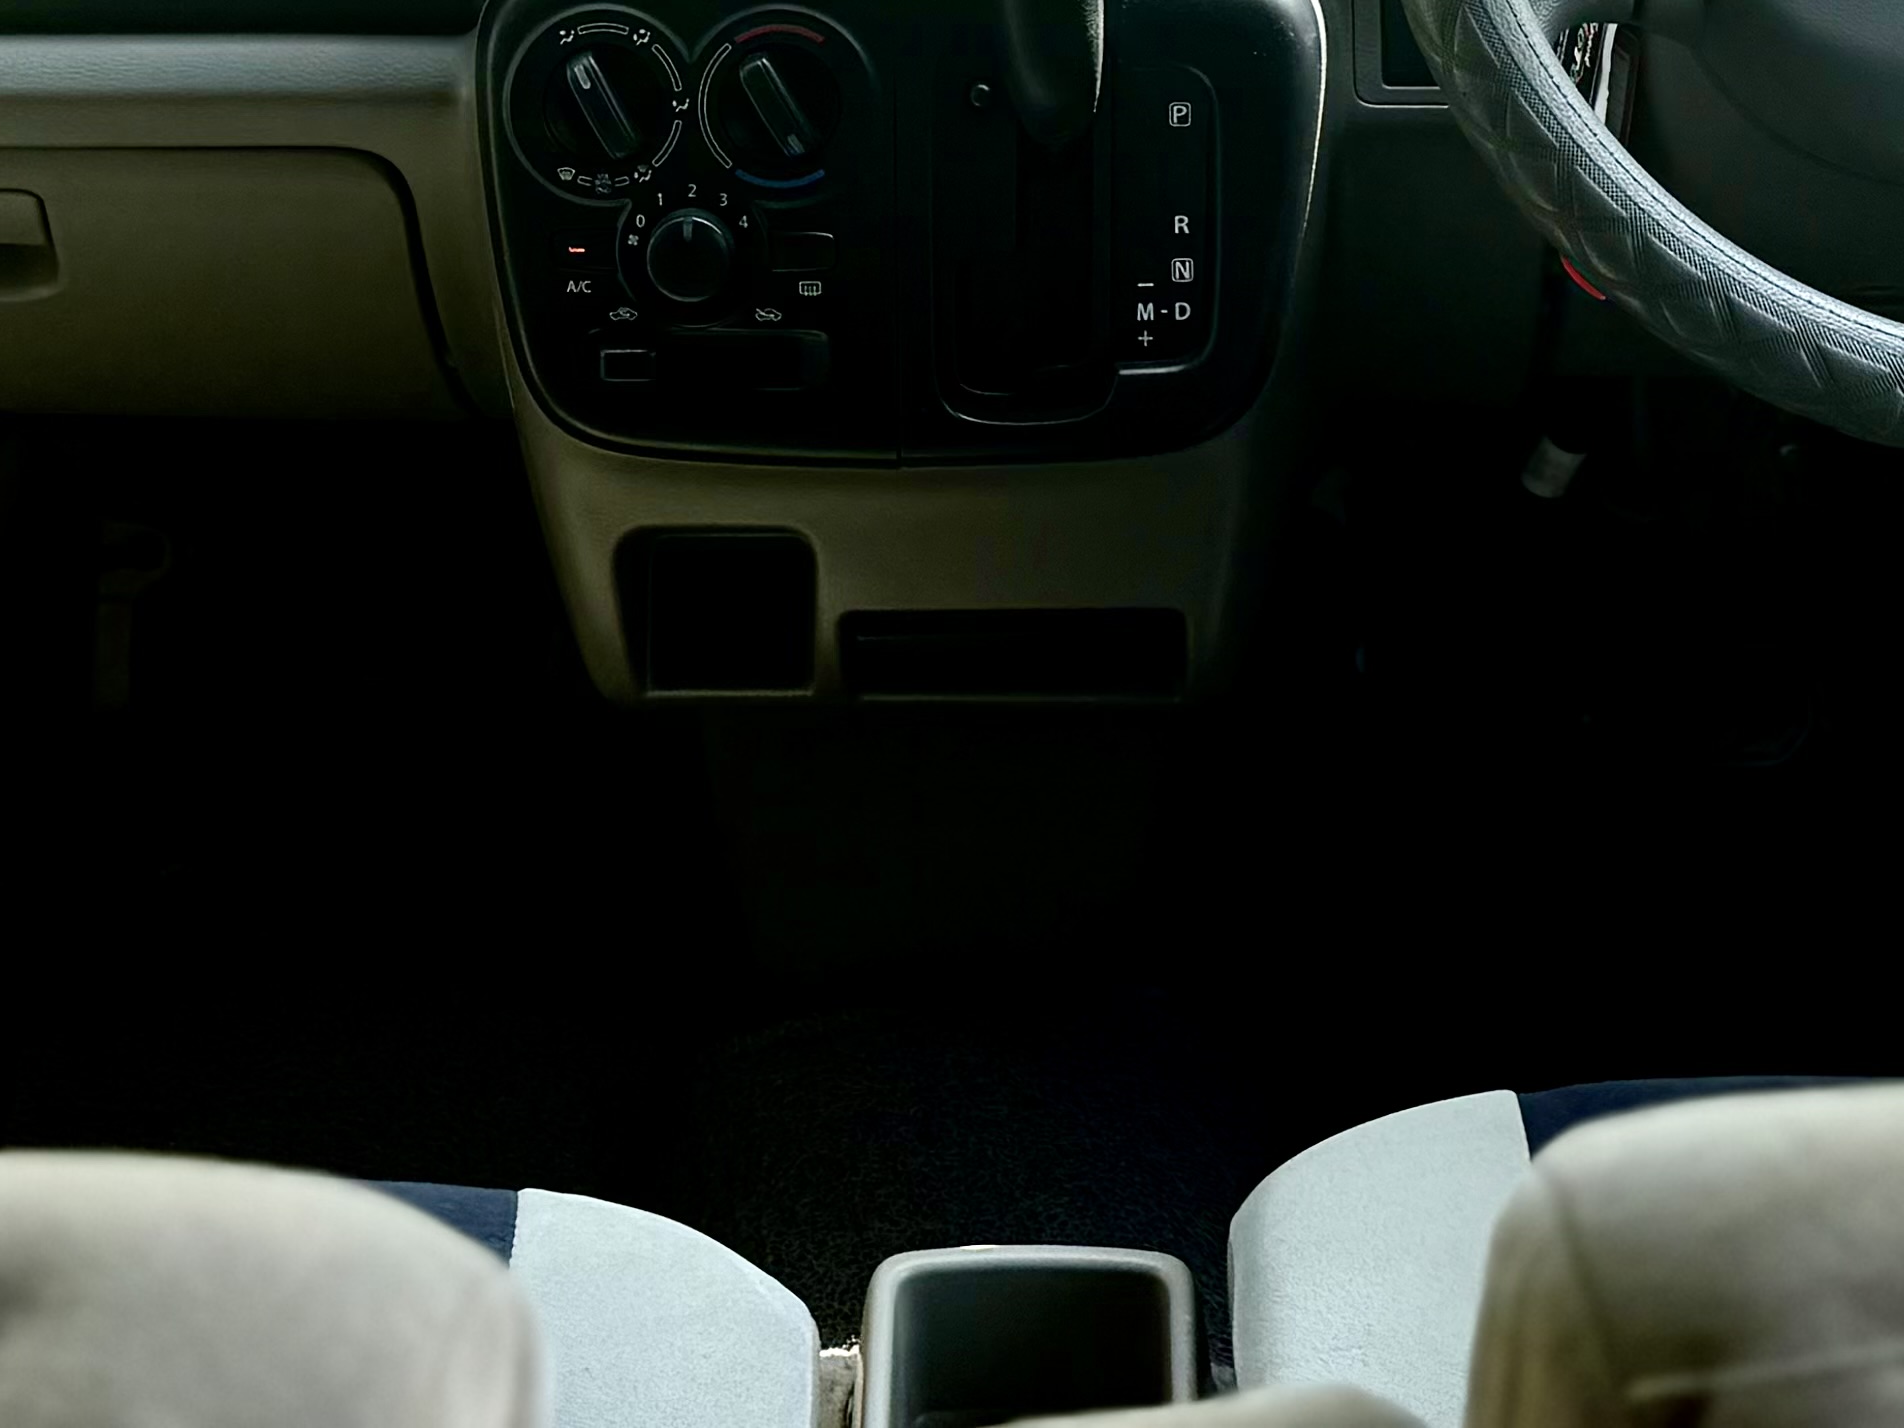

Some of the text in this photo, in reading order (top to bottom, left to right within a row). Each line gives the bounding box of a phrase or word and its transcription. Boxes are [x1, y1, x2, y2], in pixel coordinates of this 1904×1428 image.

[1172, 105, 1188, 124] P
[688, 183, 697, 198] 2
[657, 192, 664, 206] 1
[719, 193, 728, 206] 3
[635, 214, 646, 228] 0
[738, 215, 749, 229] 4
[1174, 215, 1190, 234] R
[1175, 261, 1191, 279] N
[566, 280, 592, 294] A/C
[1137, 302, 1192, 321] M D
